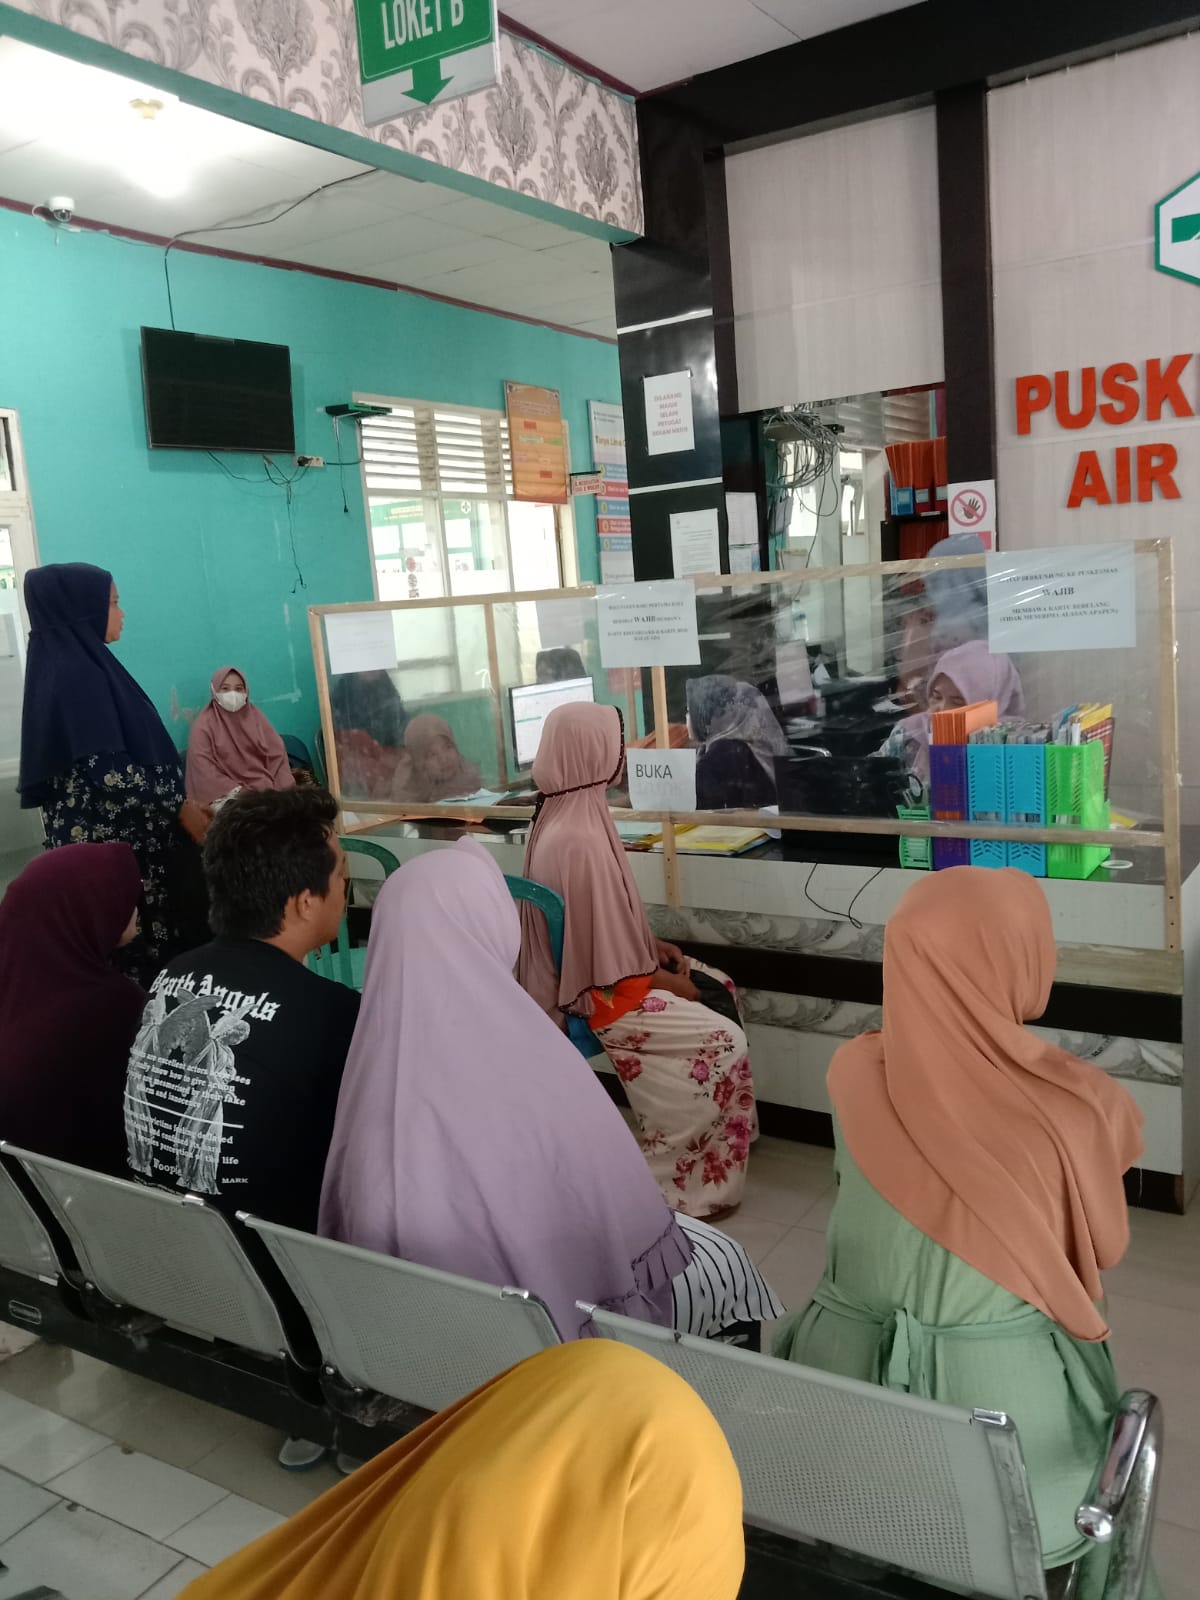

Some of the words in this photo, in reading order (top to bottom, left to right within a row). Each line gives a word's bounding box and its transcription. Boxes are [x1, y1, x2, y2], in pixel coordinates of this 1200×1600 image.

[1067, 443, 1182, 509] AIR
[1042, 587, 1075, 597] WAJIB
[634, 615, 656, 623] WAJIB
[635, 764, 673, 779] BUKA
[197, 974, 281, 1022] Angels
[222, 1156, 240, 1165] life
